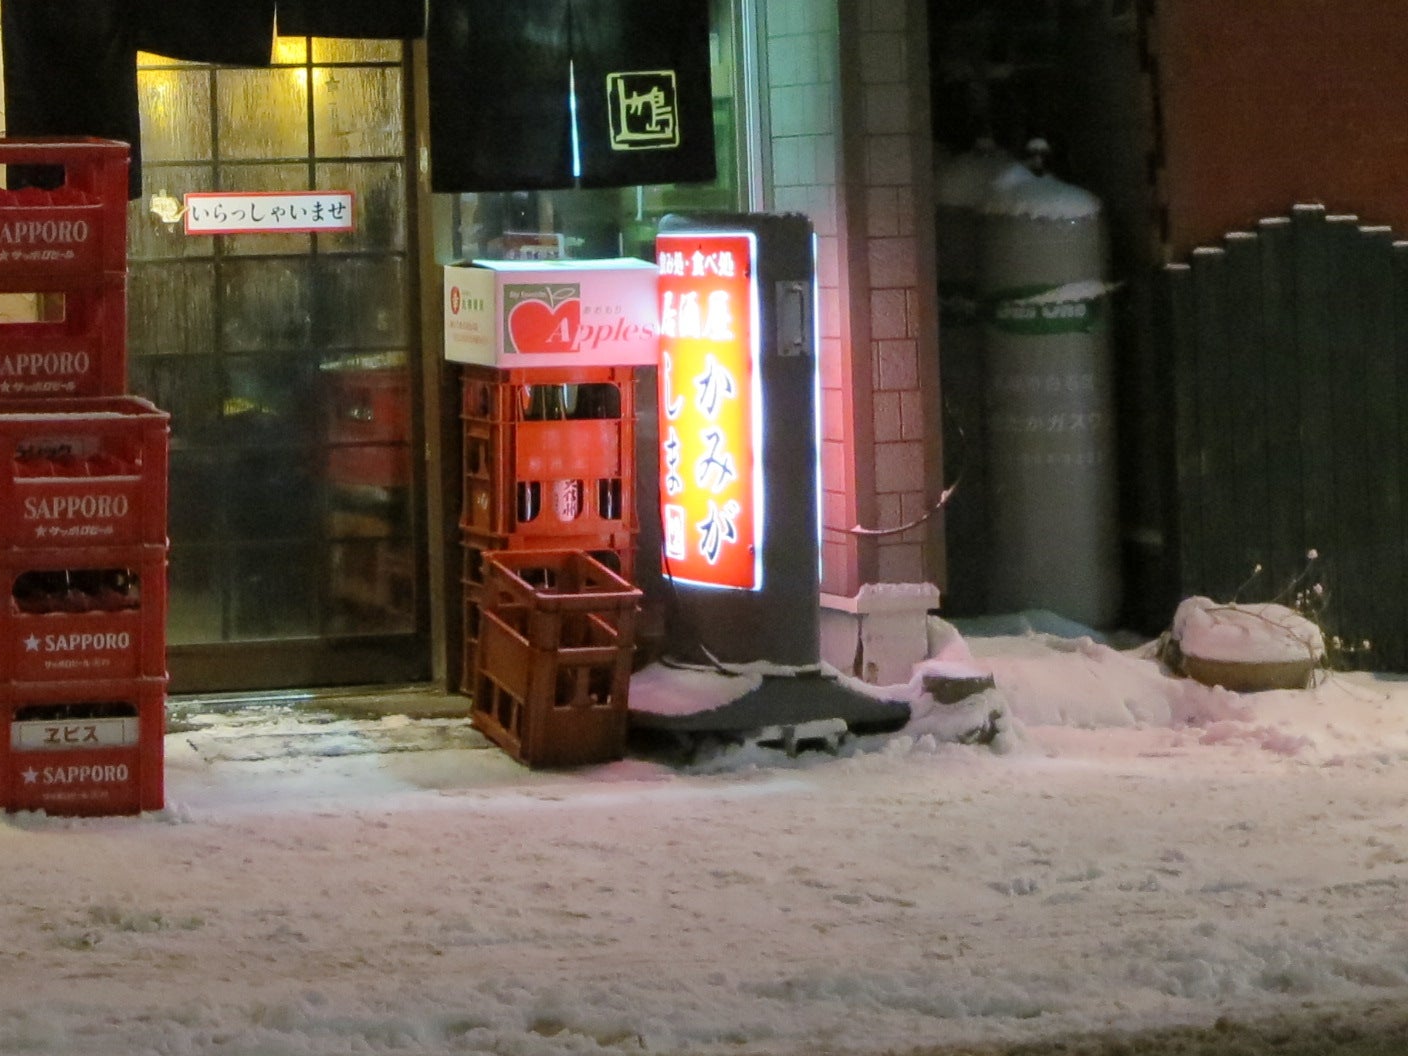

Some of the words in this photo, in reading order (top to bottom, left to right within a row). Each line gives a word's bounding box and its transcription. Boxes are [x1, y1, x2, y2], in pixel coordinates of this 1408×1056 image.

[191, 200, 347, 223] いらっしゃいませ
[545, 316, 654, 352] Apples
[23, 494, 129, 520] SAPPORO
[44, 632, 131, 652] SAPPORO
[42, 763, 130, 784] SAPPORO
